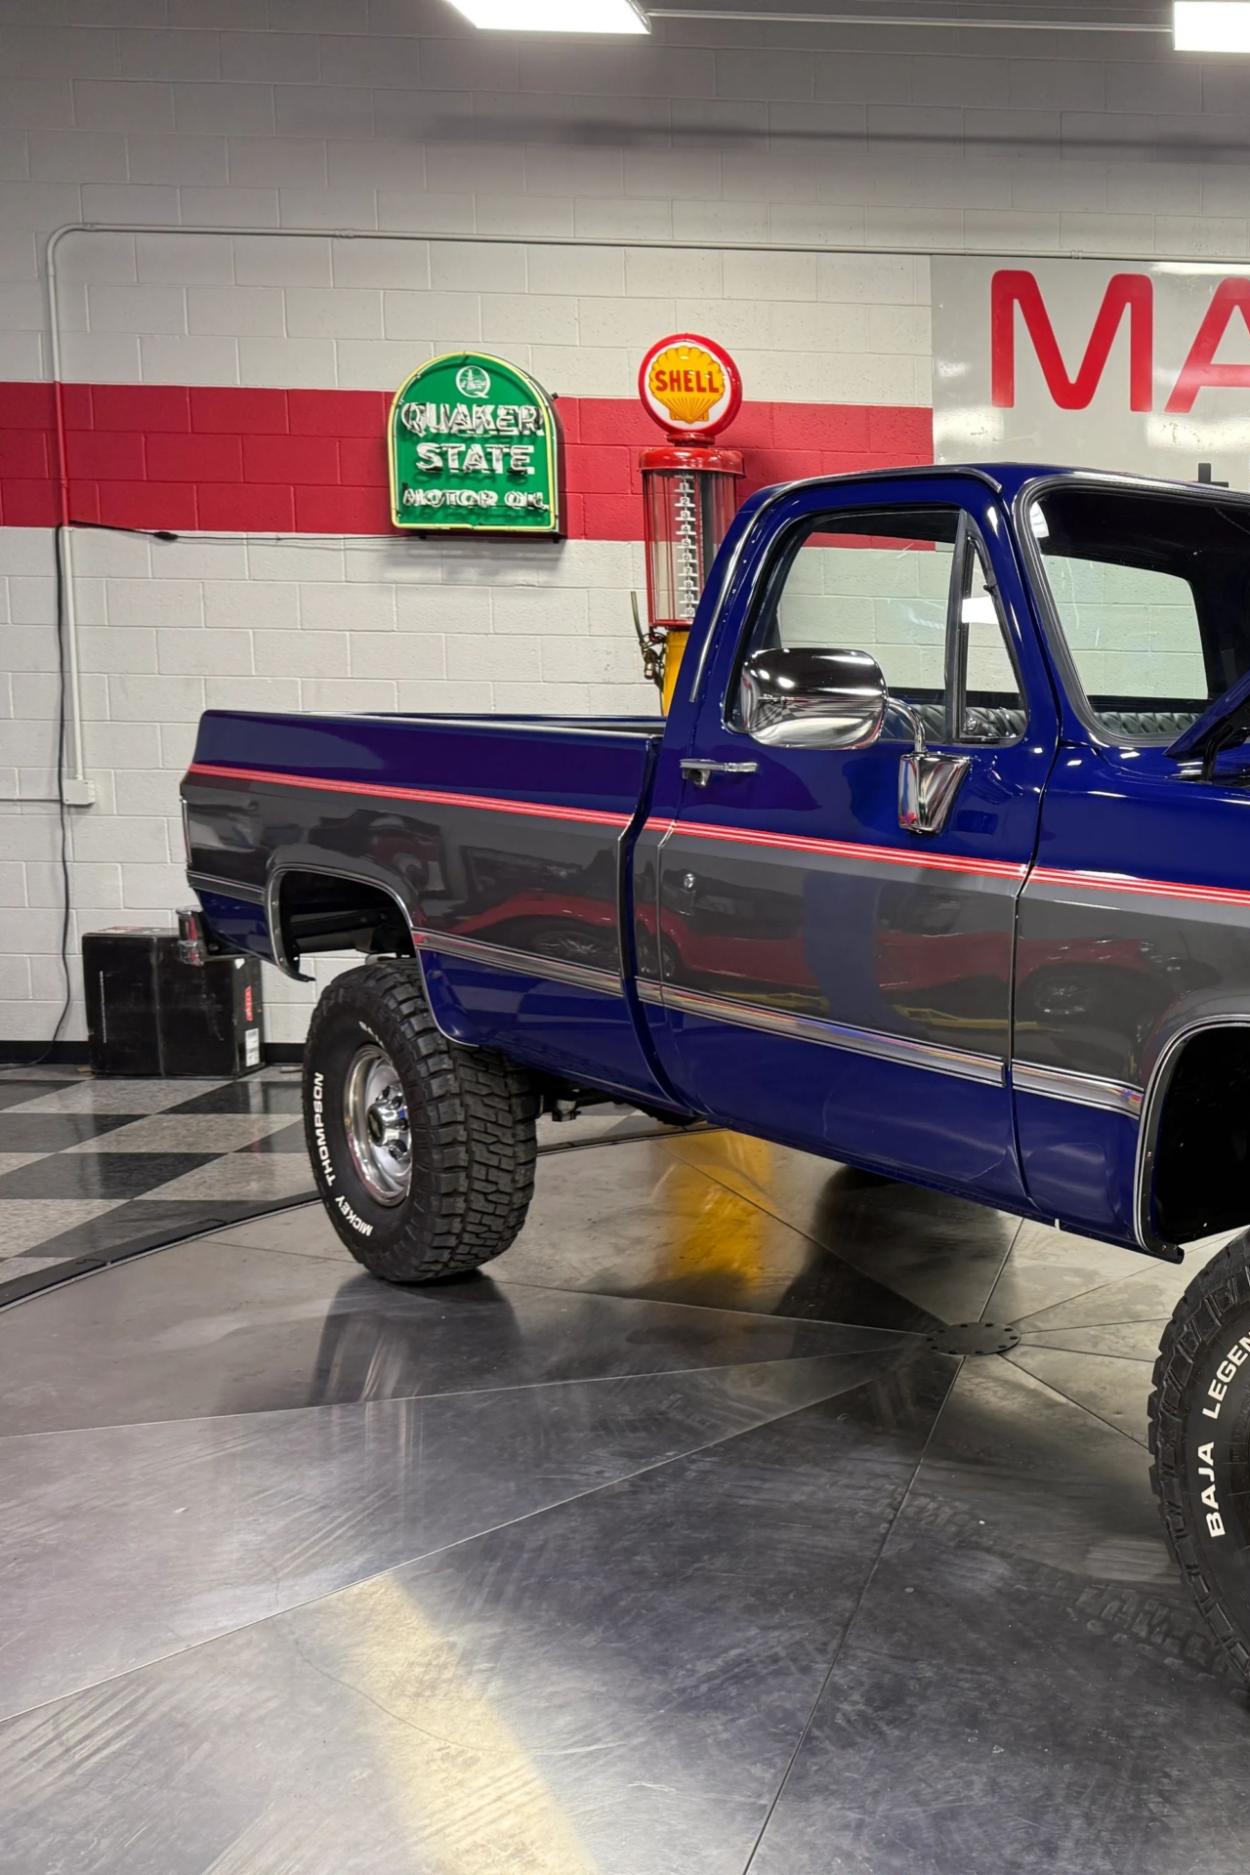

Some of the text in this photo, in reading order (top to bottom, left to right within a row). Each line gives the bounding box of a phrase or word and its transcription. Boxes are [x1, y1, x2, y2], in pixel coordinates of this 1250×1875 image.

[654, 369, 720, 394] SHELL
[401, 402, 545, 437] QUAKER
[416, 442, 536, 475] STATE
[403, 488, 549, 510] MOTOR OIL
[313, 1072, 374, 1237] MICKEY THOMPSON
[1197, 1441, 1226, 1538] BAJA
